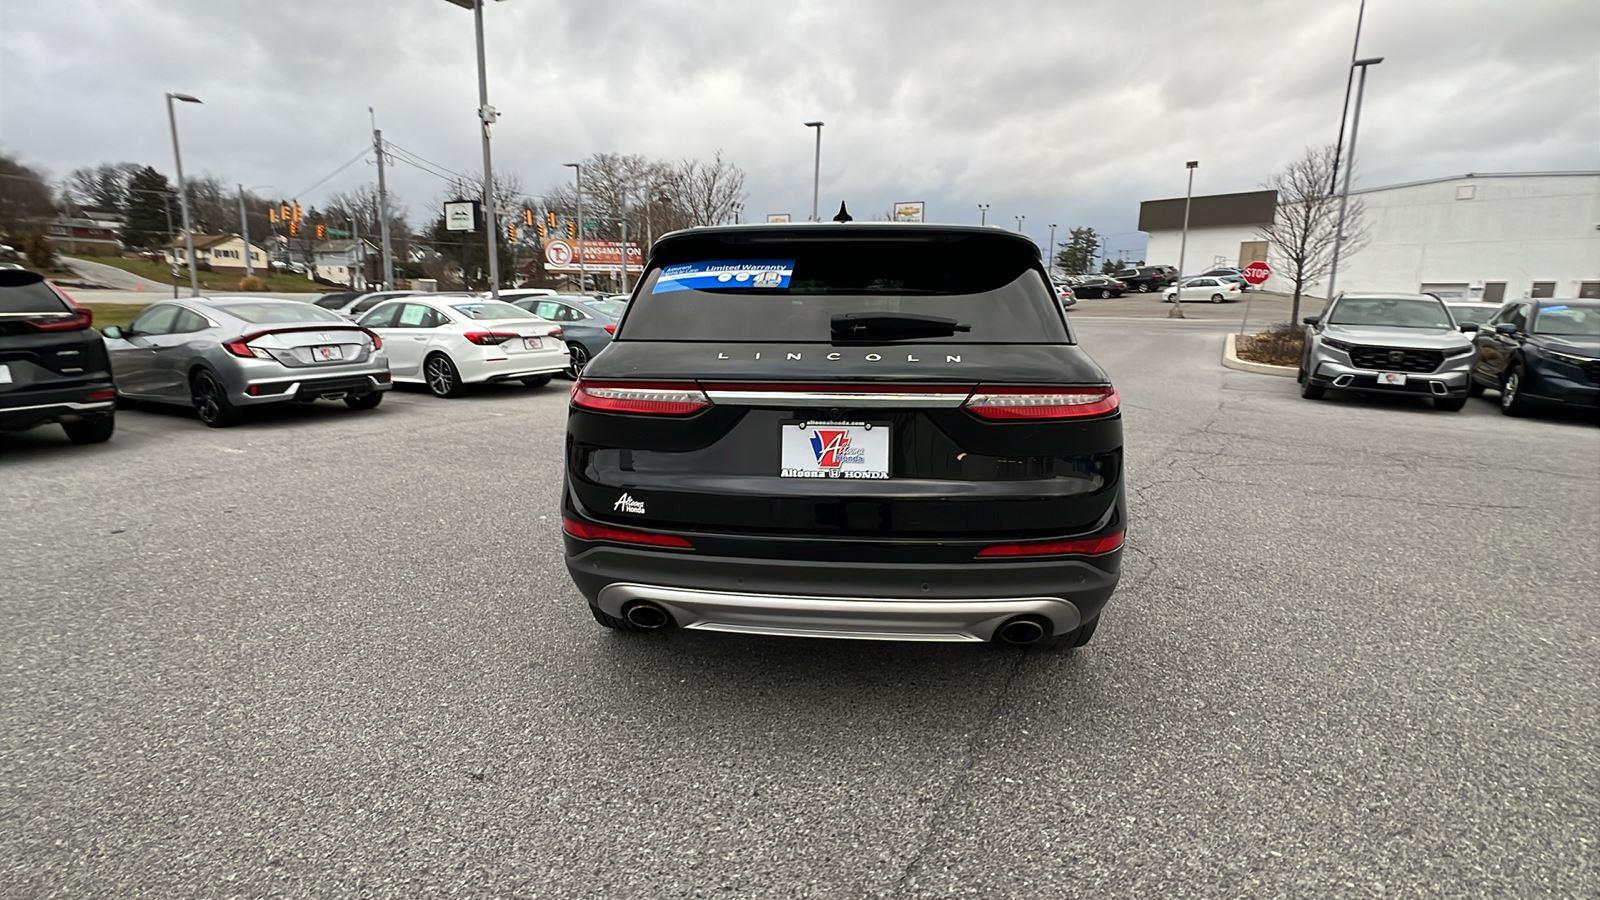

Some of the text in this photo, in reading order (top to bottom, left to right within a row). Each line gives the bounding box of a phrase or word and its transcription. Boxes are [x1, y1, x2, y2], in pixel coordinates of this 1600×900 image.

[742, 264, 787, 272] Warranty
[1244, 268, 1269, 278] STOP
[717, 352, 962, 364] LINCOLN
[781, 469, 825, 478] Altoona
[844, 471, 889, 479] HONDA
